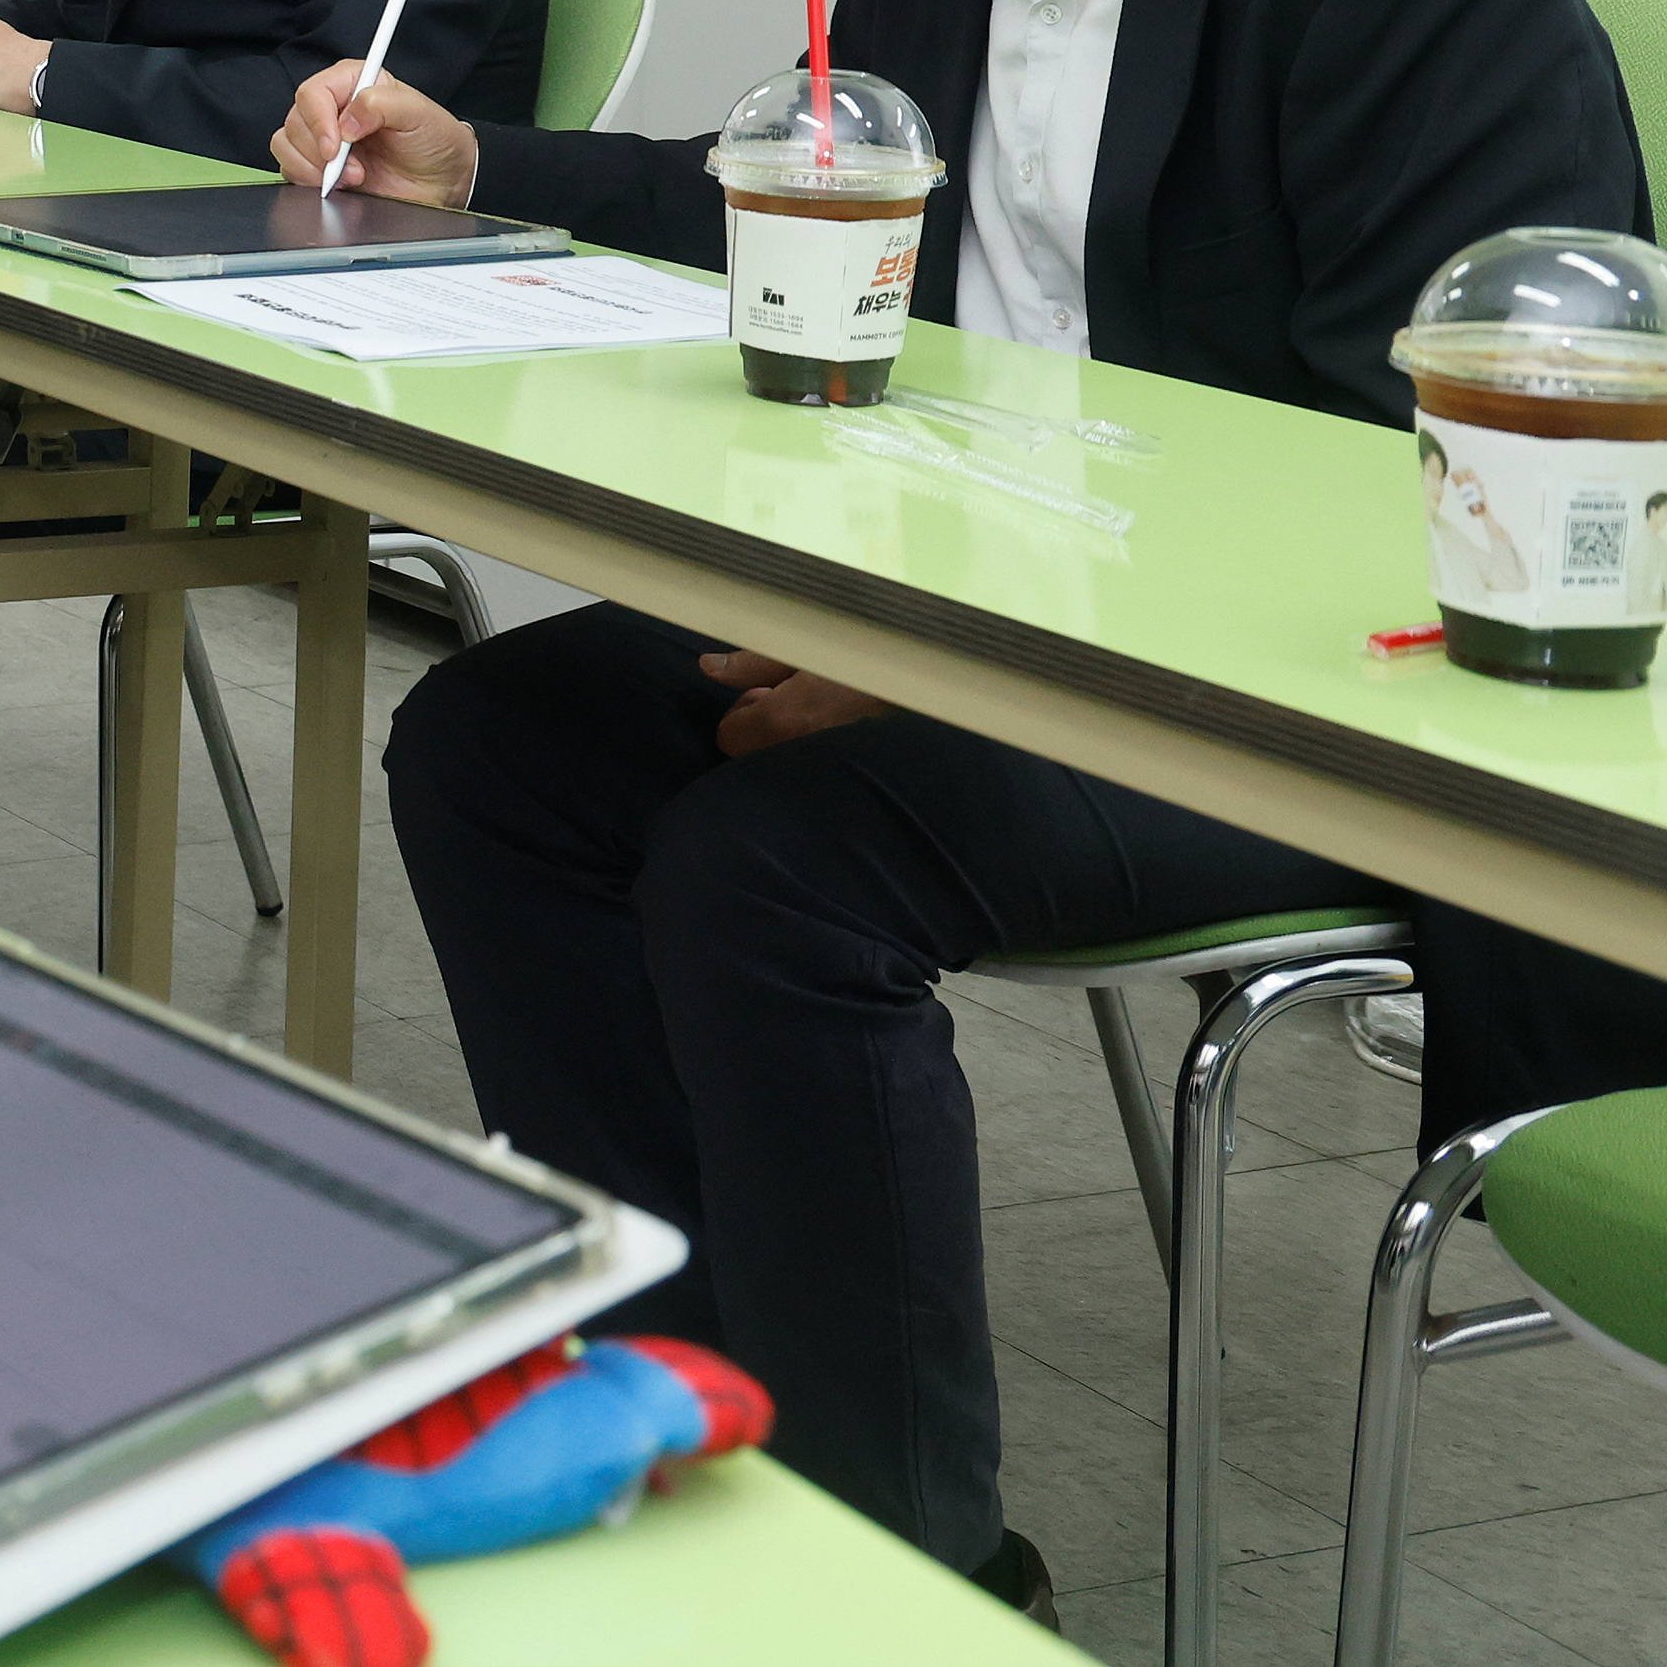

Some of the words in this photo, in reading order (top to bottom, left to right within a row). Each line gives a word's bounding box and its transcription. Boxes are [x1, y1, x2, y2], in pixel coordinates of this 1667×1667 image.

[885, 232, 913, 254] 우리의
[853, 290, 901, 317] 채우는
[850, 332, 887, 342] MAMMOTH
